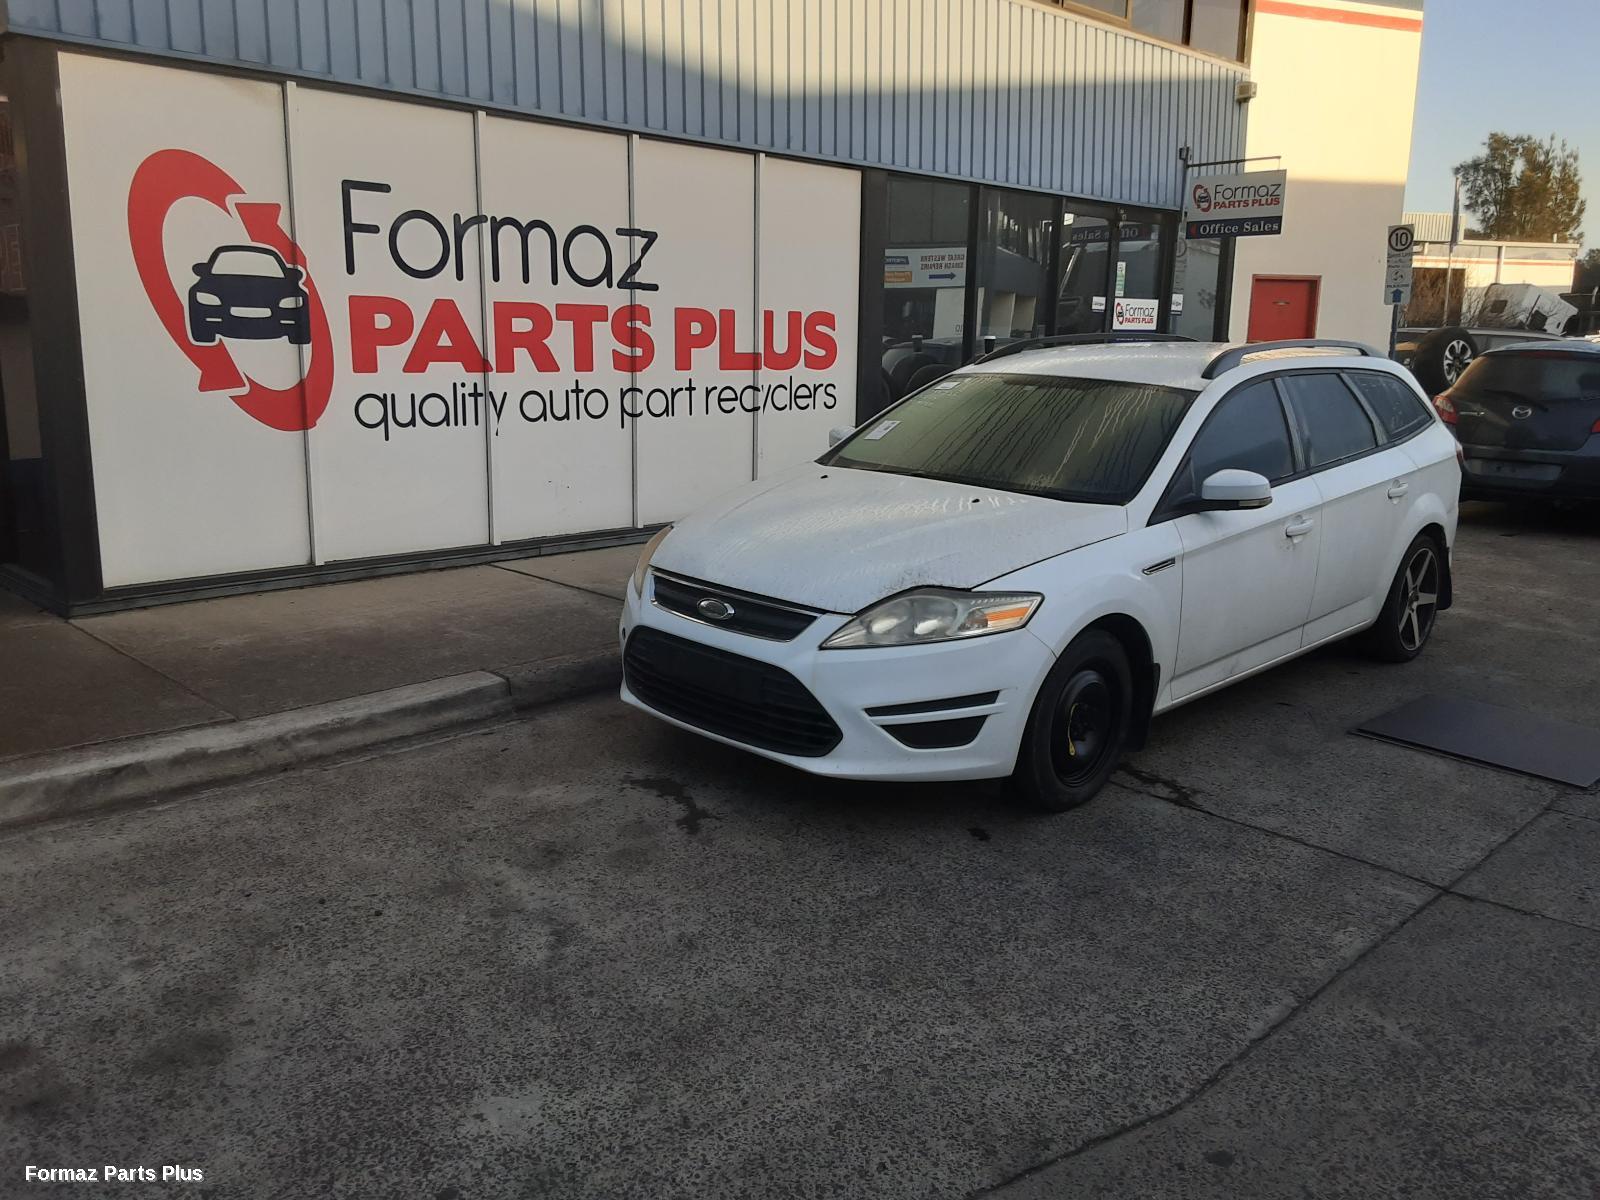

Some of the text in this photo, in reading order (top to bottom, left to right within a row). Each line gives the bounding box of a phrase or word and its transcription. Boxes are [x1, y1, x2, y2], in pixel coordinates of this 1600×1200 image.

[1214, 184, 1282, 200] Formaz
[1213, 197, 1281, 209] PARTS PLUS
[341, 178, 659, 292] Formaz
[1200, 220, 1280, 235] Office Sales
[1394, 231, 1409, 247] 10
[1125, 303, 1155, 317] Formaz
[348, 294, 838, 374] PARTS PLUS
[354, 375, 837, 442] quality auto part recyclers
